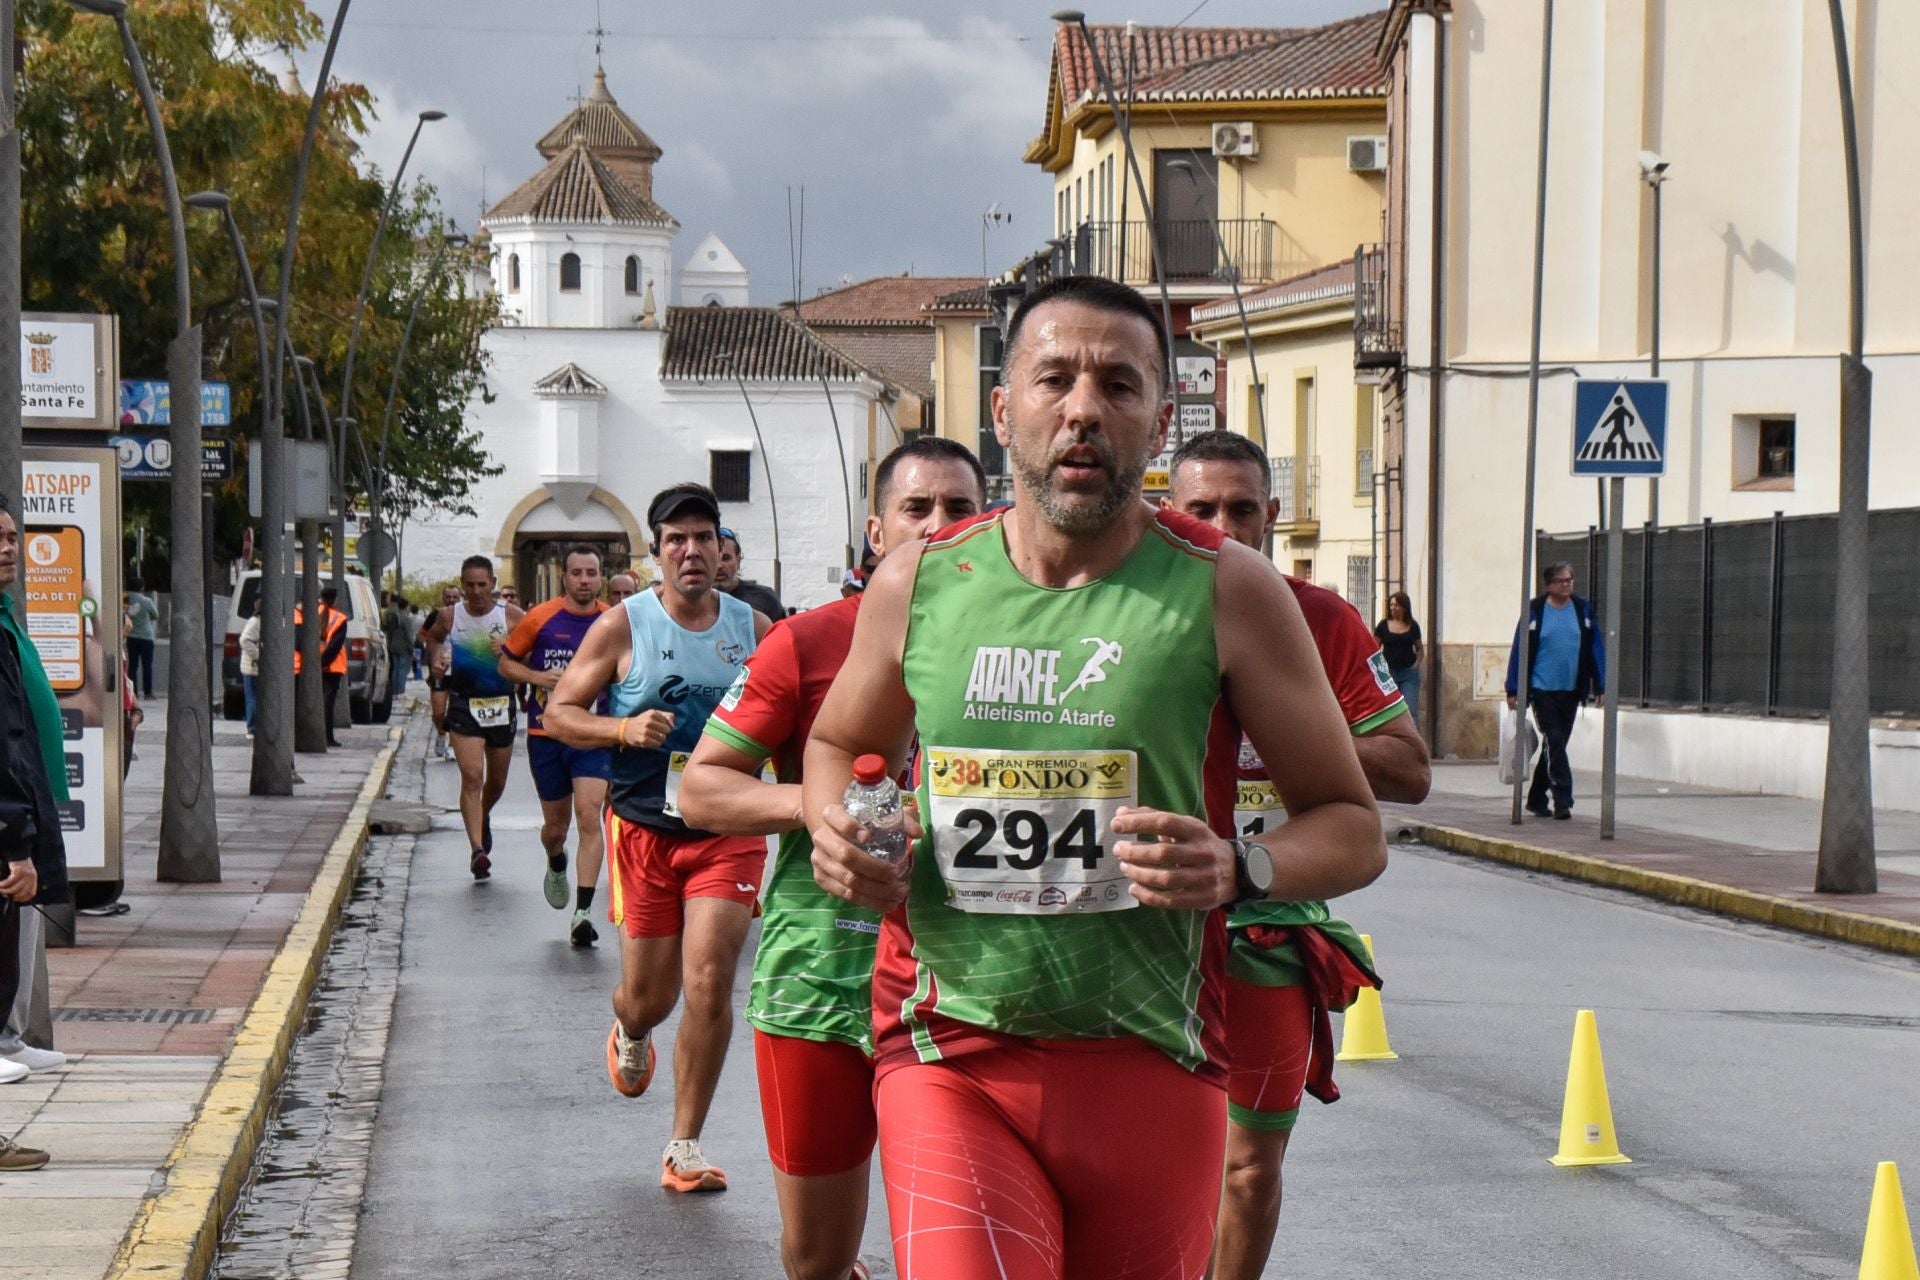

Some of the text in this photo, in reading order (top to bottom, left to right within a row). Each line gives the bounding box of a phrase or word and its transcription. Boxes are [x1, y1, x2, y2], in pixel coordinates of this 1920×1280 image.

[20, 383, 85, 394] ntamiento
[68, 396, 85, 409] Fe
[1182, 407, 1210, 416] icena
[1182, 418, 1210, 428] Salud
[1160, 459, 1168, 468] la
[24, 473, 91, 496] ATSAPP
[22, 496, 76, 514] ANTA FE
[26, 566, 74, 575] UNTAMIENTO
[25, 591, 77, 601] RCA DE TI
[964, 646, 1062, 706] ATARFE
[963, 703, 1117, 728] Atletismo Atarfe
[951, 758, 982, 786] 38
[987, 758, 1023, 769] GRAN
[1027, 760, 1078, 769] PREMIO
[982, 768, 1089, 790] FONDO
[953, 808, 1104, 871] 294
[836, 919, 879, 932] www.farm
